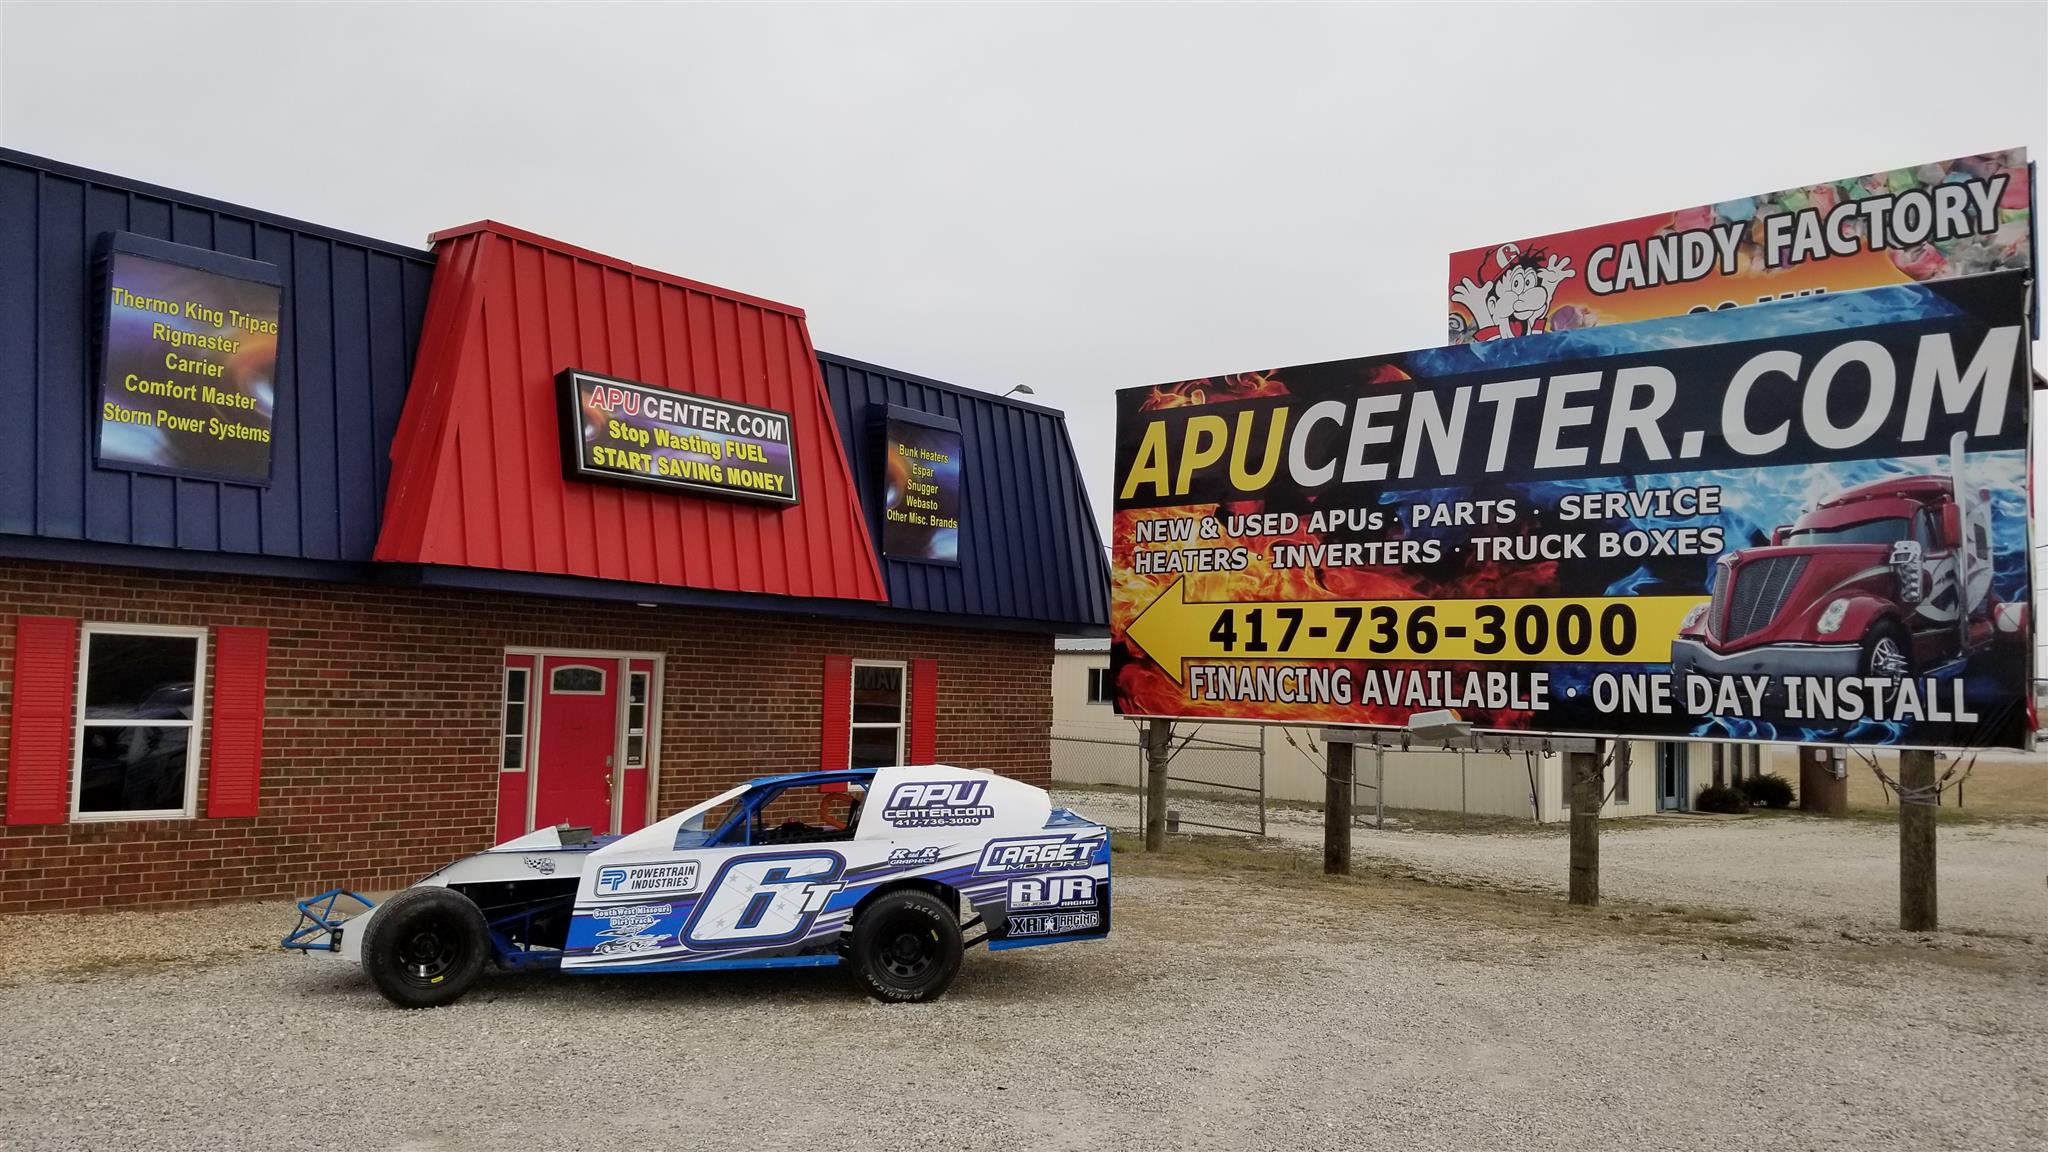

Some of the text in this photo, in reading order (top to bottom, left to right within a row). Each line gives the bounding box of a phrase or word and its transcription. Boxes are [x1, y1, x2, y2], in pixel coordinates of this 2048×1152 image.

[1588, 175, 2009, 294] CANDY FACTORY
[112, 287, 278, 335] Thermo King Tripac
[153, 322, 239, 354] Rigmaster
[165, 353, 224, 378] Carrier
[125, 374, 257, 410] Comfort Master
[103, 402, 270, 443] Storm Power Systems
[1120, 326, 2021, 499] APUCENTER.COM
[609, 420, 768, 463] Stop Wasting FUEL
[899, 444, 949, 463] Bunk Heaters
[593, 446, 784, 491] START SAVING MONEY
[912, 464, 934, 478] Espar
[907, 479, 939, 495] Snugger
[906, 495, 938, 511] Webasto
[1136, 486, 1721, 542] NEW & USED APUs PARTS SERVICE
[887, 508, 957, 529] Other Misc. Brands
[1134, 526, 1725, 574] HEATERS INVERTERS TRUCK BOXES
[1209, 603, 1638, 655] 417-736-3000
[1190, 666, 1979, 723] FINANCING AVAILABLE ONE DAY INSTALL
[890, 783, 982, 807] APU
[884, 807, 991, 819] CENTER.COM
[895, 817, 979, 825] 417-736-3000
[630, 865, 696, 879] POWERTRAIN
[1005, 859, 1089, 871] MOTORS
[631, 877, 688, 890] INDUSTRIES
[612, 916, 652, 926] Dirt Track
[637, 905, 670, 914] Missouri
